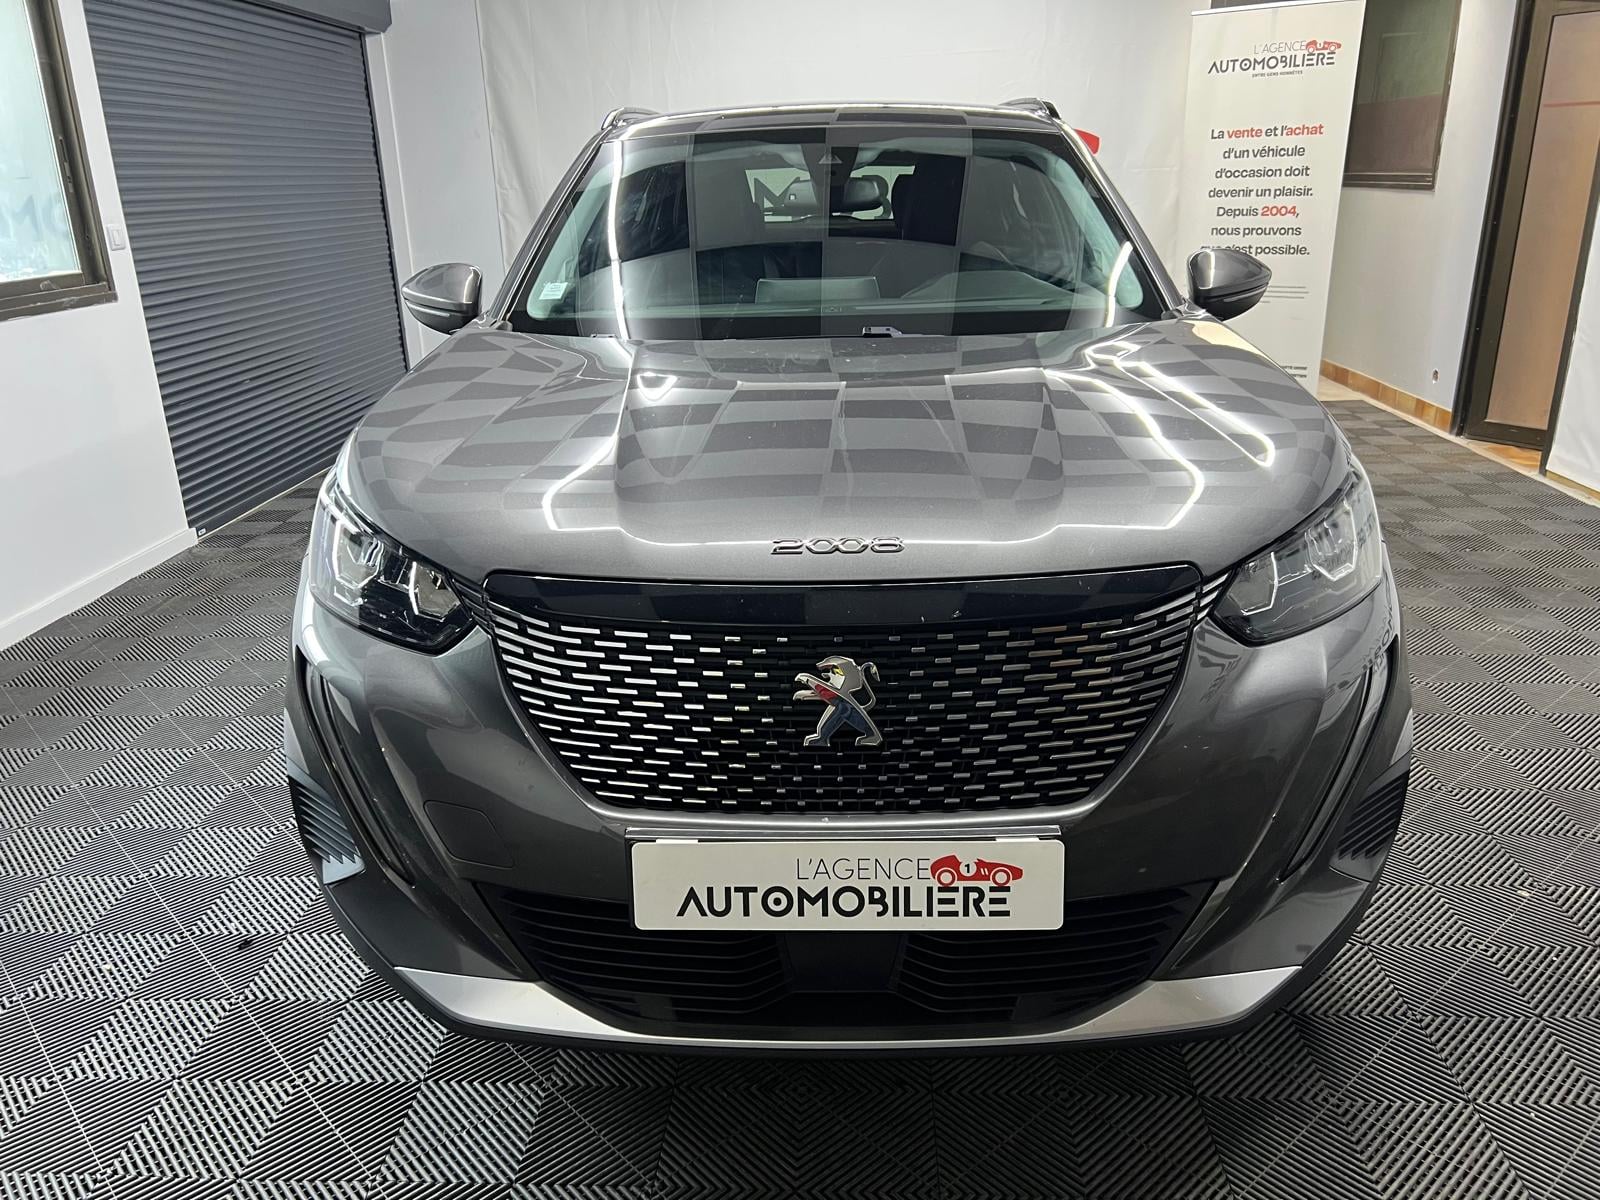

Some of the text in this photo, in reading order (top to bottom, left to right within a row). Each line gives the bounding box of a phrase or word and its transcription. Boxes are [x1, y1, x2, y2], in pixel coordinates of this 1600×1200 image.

[1253, 40, 1306, 54] L'AGENCE
[1211, 123, 1324, 139] La vente et l'achat
[1222, 145, 1305, 159] d'un véhicule
[1215, 165, 1310, 179] d'occasion doit
[1208, 186, 1313, 199] devenir un plaisir.
[1216, 205, 1300, 218] Depuis 2004,
[1211, 226, 1302, 237] nous prouvons
[1255, 244, 1310, 256] possible.
[771, 537, 905, 555] 2008
[796, 857, 970, 881] L'AGENCE 1
